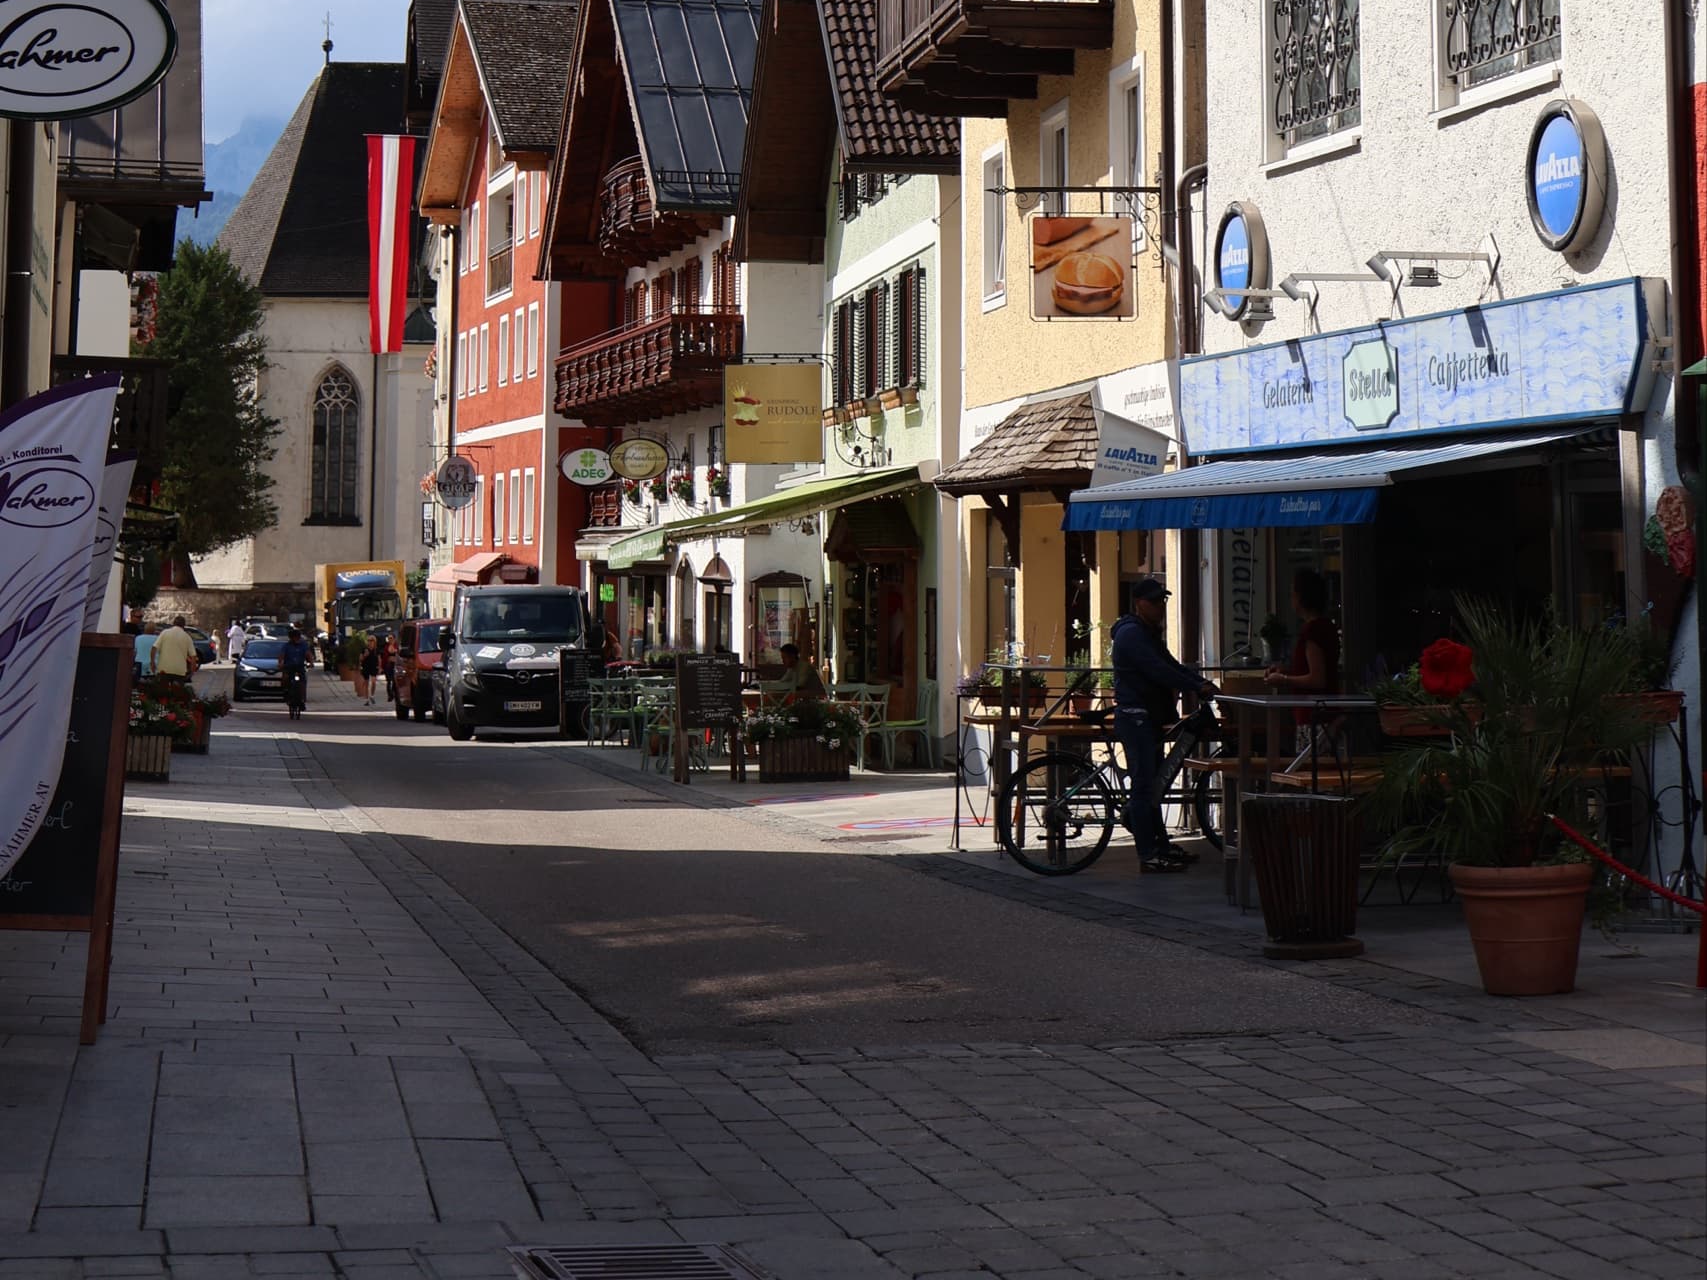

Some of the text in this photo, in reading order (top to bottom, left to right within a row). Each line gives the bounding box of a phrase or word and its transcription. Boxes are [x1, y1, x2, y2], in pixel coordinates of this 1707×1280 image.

[0, 28, 120, 70] ahmer
[1429, 347, 1510, 393] Caffetteria
[1263, 377, 1314, 409] Gelateria
[1349, 368, 1391, 402] Stella
[767, 406, 818, 416] RUDOLF
[12, 445, 63, 460] Konditorei
[1104, 448, 1158, 466] LAVAZZA
[571, 469, 606, 478] ADEG
[345, 569, 390, 578] DACHSER
